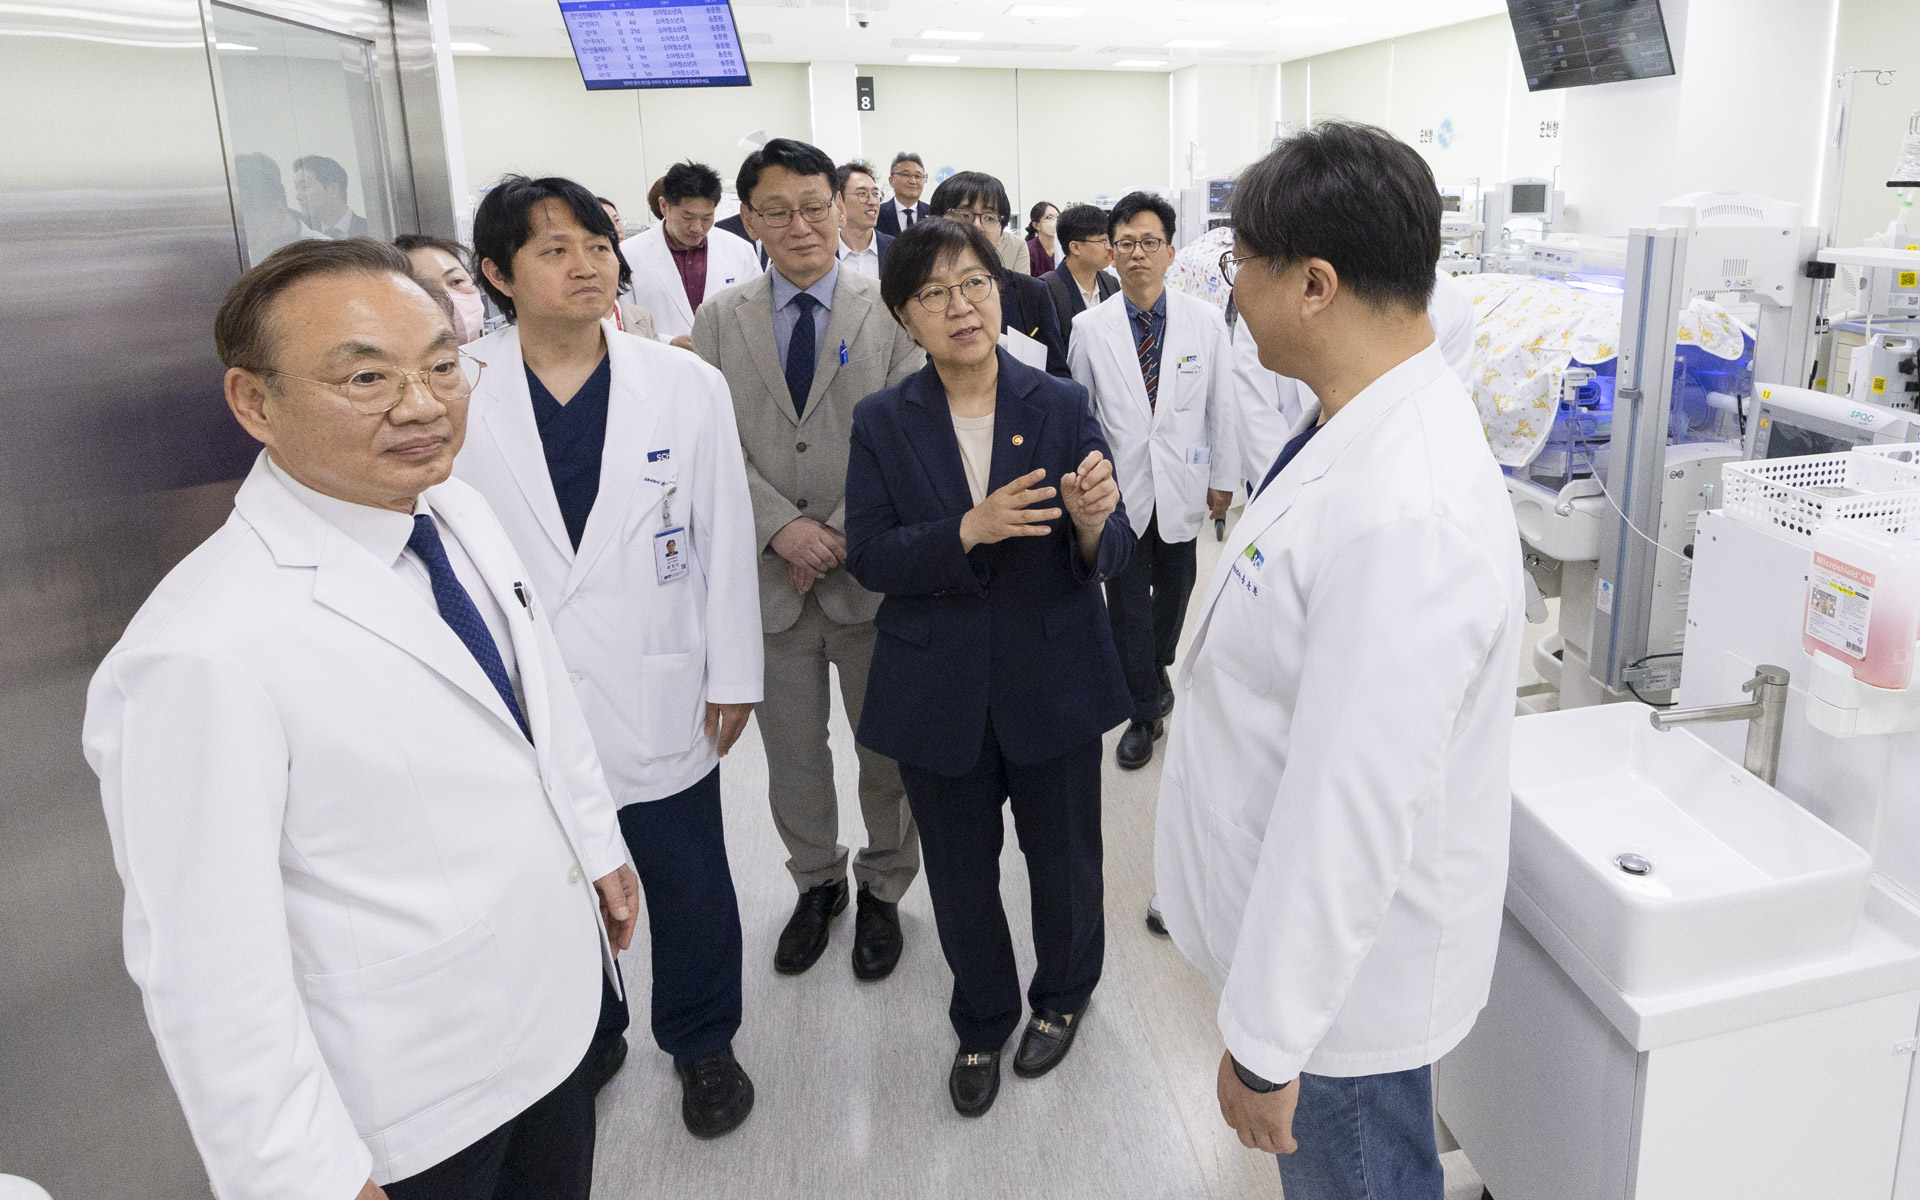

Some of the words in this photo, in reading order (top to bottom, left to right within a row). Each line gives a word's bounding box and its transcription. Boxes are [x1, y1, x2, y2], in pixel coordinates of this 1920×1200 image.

[861, 96, 871, 109] 8
[1540, 120, 1558, 138] 순천향
[1420, 128, 1434, 144] 순천향
[1763, 390, 1770, 399] 13
[1850, 410, 1874, 423] SPQC
